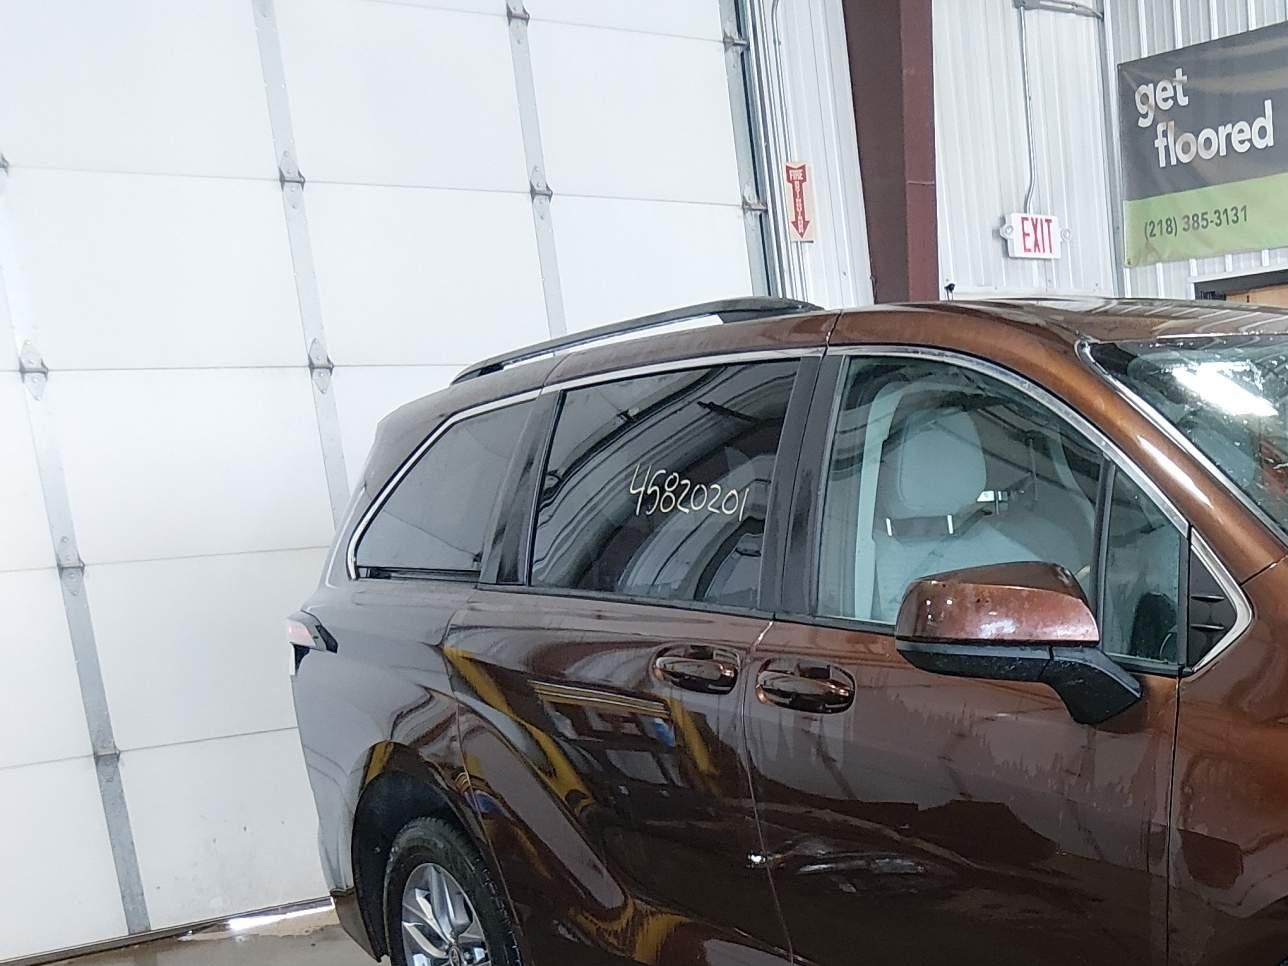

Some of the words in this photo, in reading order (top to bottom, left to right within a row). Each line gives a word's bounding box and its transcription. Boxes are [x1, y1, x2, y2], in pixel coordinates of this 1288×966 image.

[1135, 68, 1188, 128] get
[1154, 99, 1274, 168] floored
[1021, 217, 1053, 253] EXIT
[1144, 216, 1178, 241] (218)
[1182, 205, 1247, 232] 385-3131
[629, 463, 750, 522] 45820201
